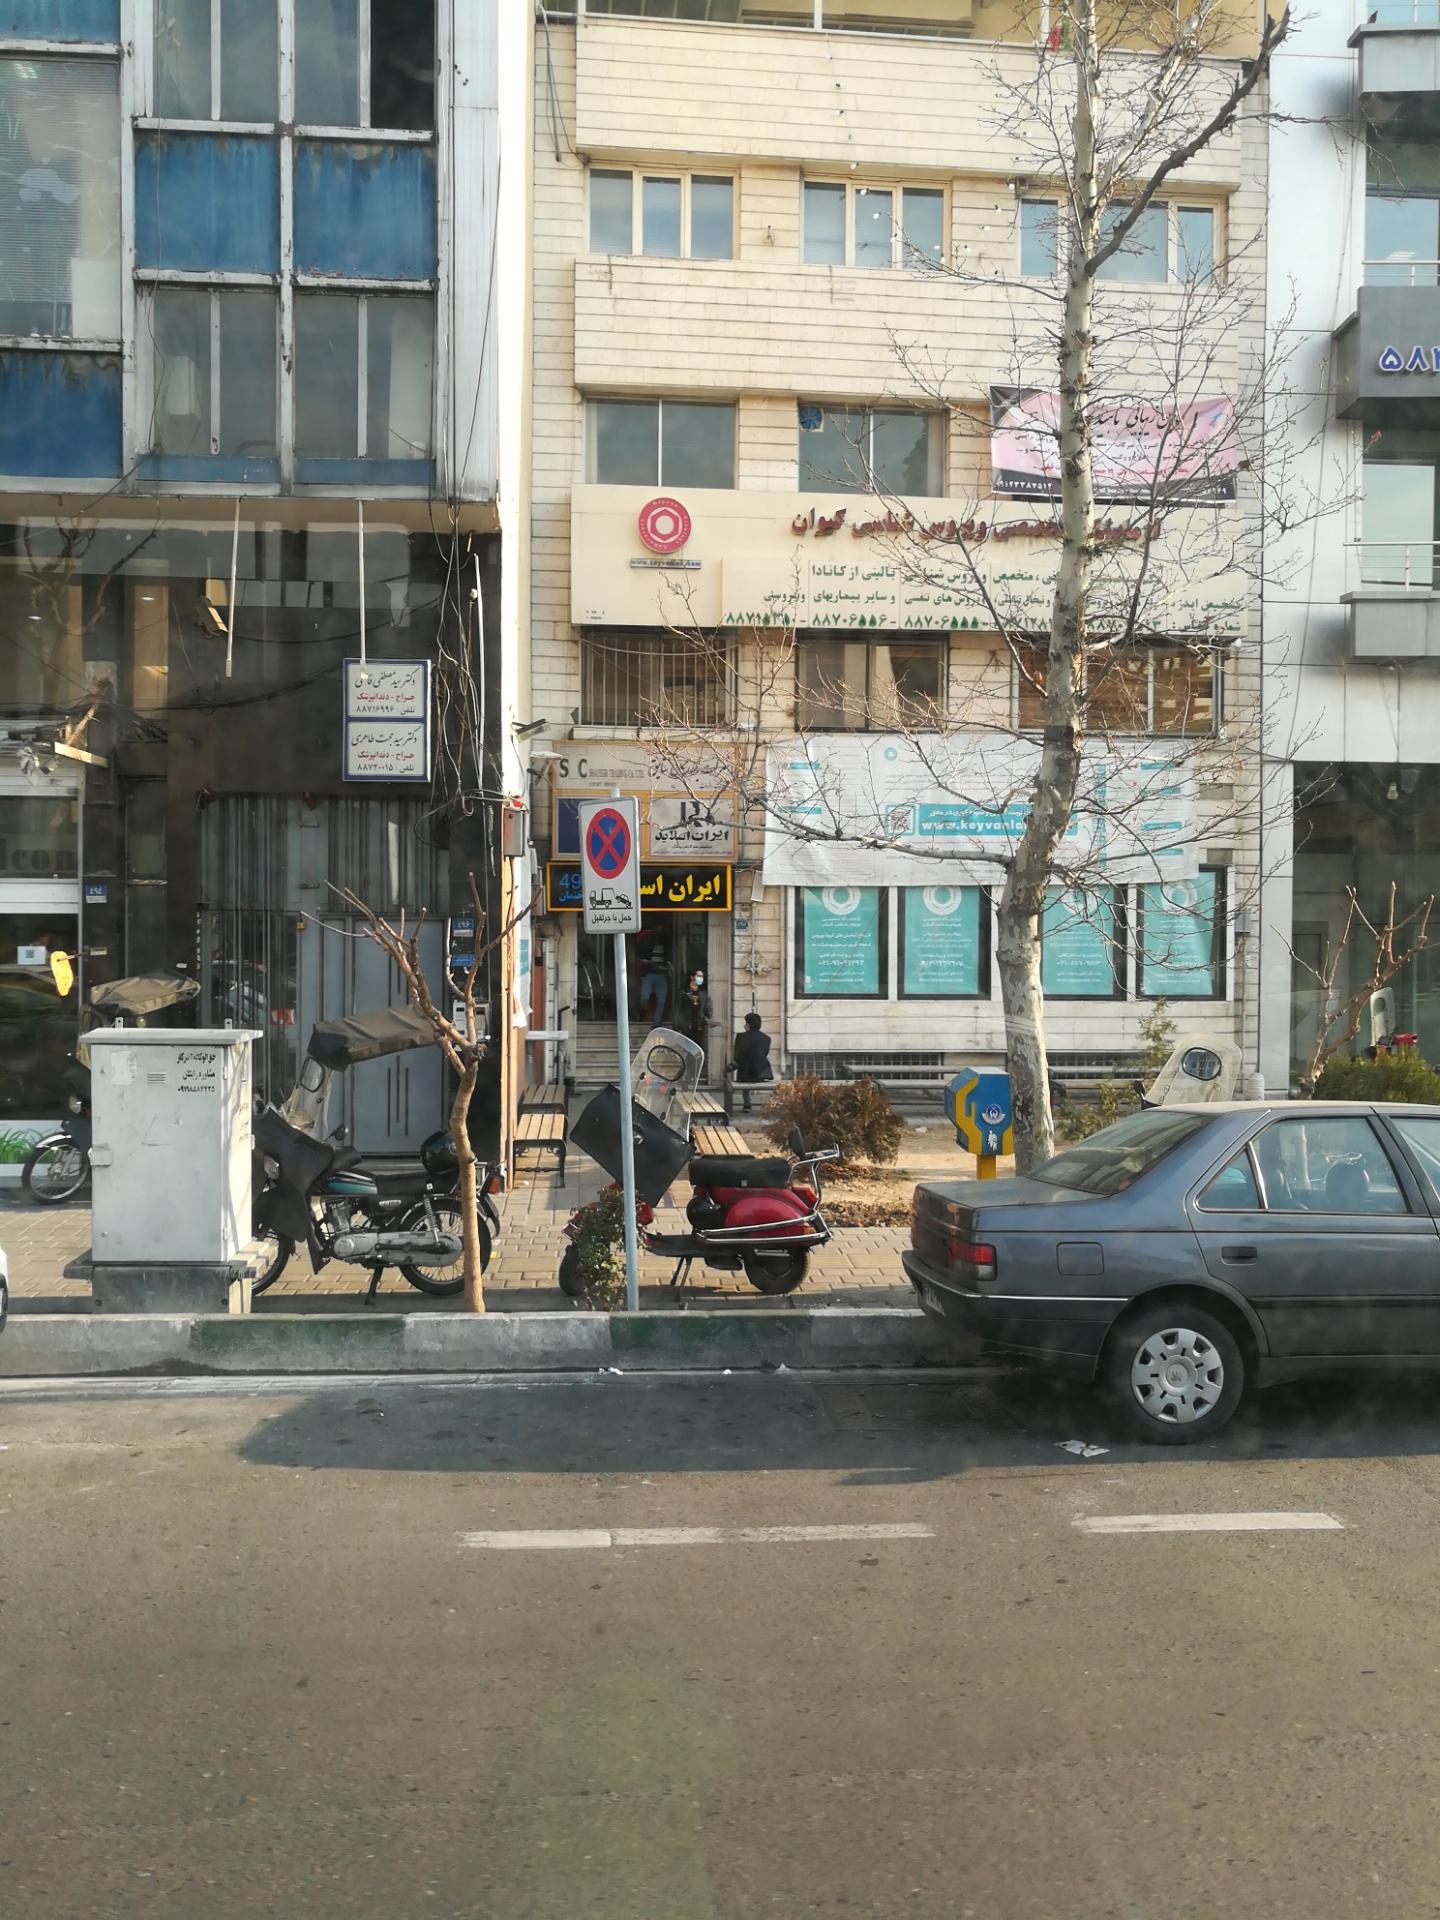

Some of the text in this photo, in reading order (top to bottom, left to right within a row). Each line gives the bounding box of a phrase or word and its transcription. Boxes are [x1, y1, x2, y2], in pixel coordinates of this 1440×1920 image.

[791, 507, 847, 537] کیوان
[812, 565, 847, 577] کانادا
[849, 565, 858, 581] از
[862, 565, 896, 581] بالینی
[863, 591, 888, 605] سایر
[356, 692, 389, 703] دندانپزشک
[357, 751, 389, 761] دندانپزشک
[668, 874, 721, 903] ایران
[591, 912, 632, 925] حمل با جرثقیل
